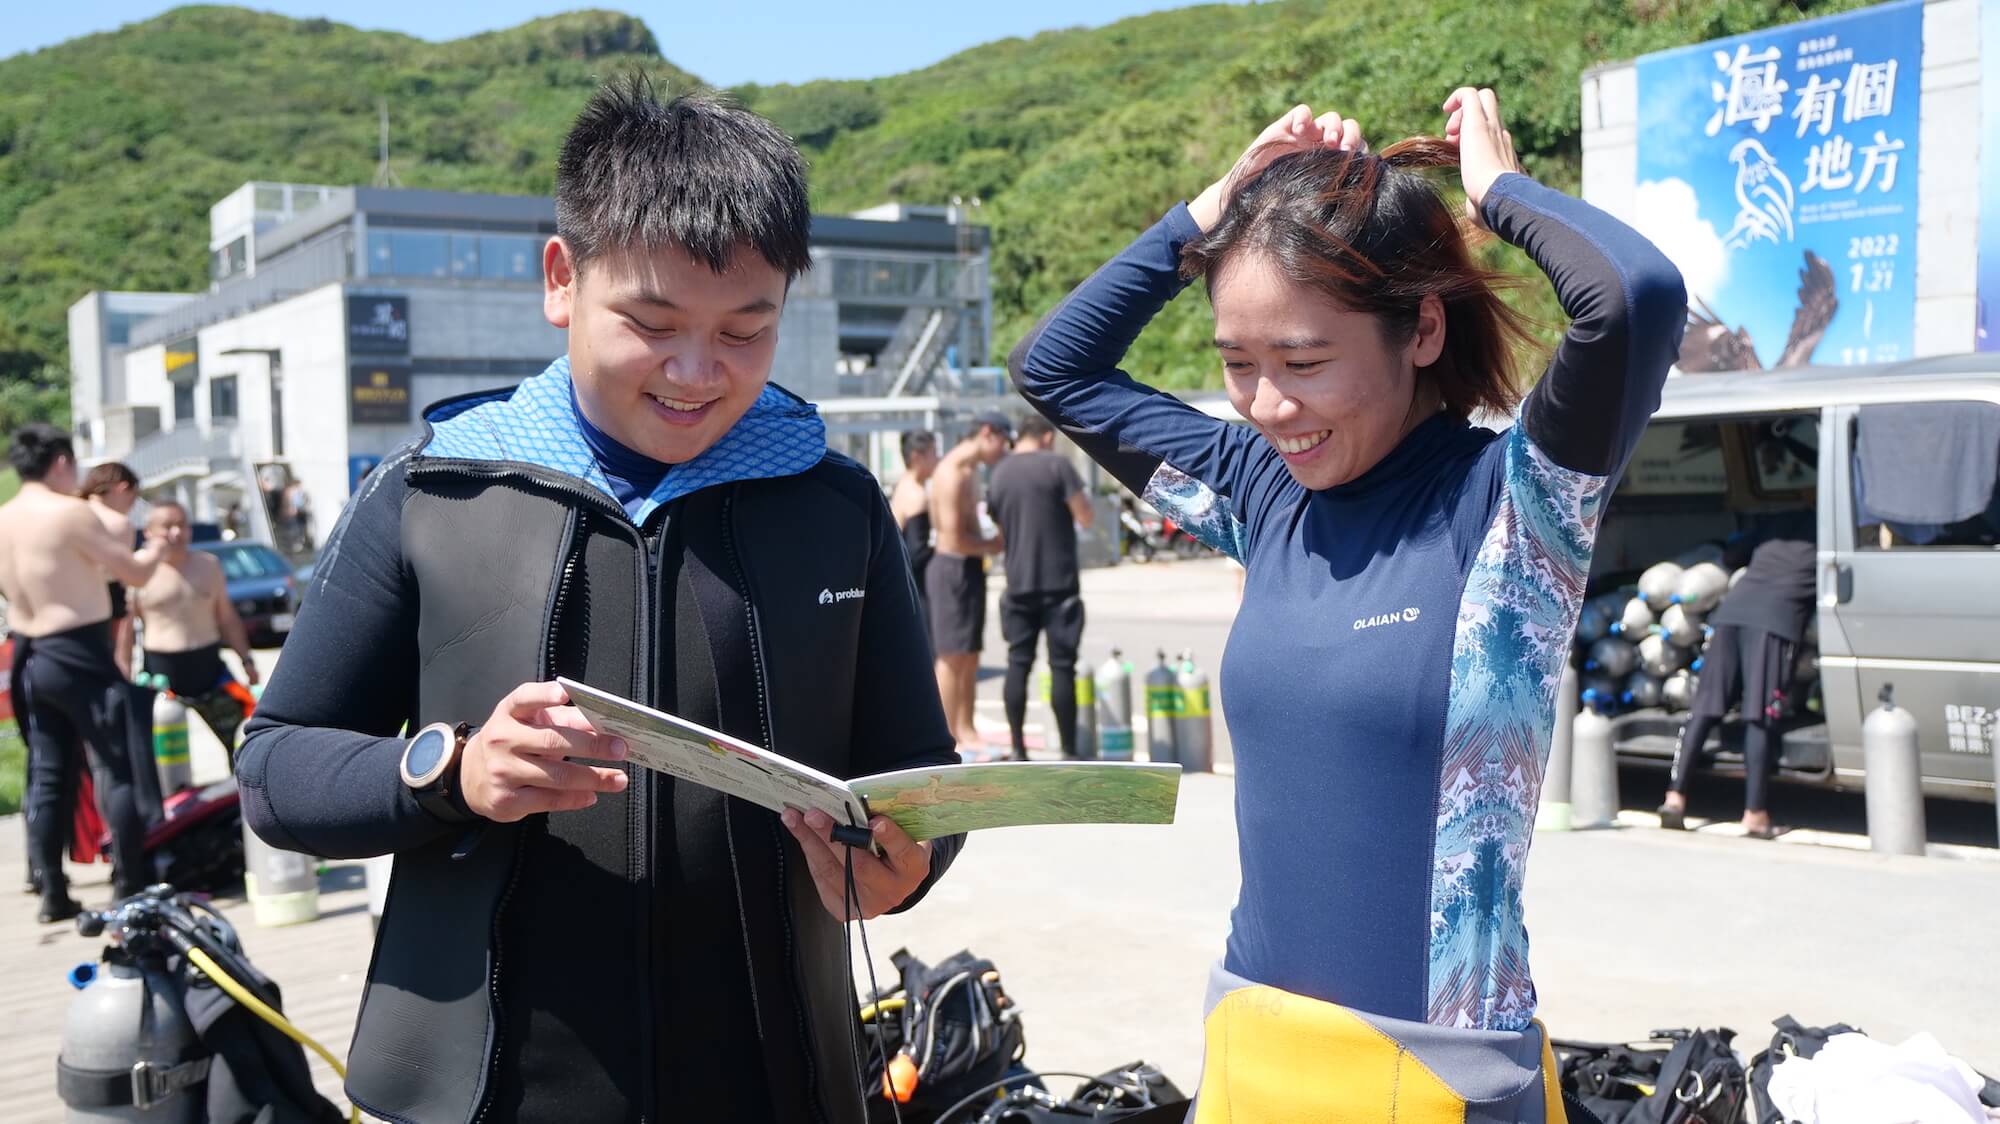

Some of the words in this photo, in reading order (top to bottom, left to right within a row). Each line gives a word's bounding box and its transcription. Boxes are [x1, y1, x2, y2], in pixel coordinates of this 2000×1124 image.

[1704, 43, 1898, 139] 海有個
[1800, 130, 1905, 194] 地方
[1847, 233, 1899, 259] 2022
[1353, 612, 1400, 630] OLAIAN
